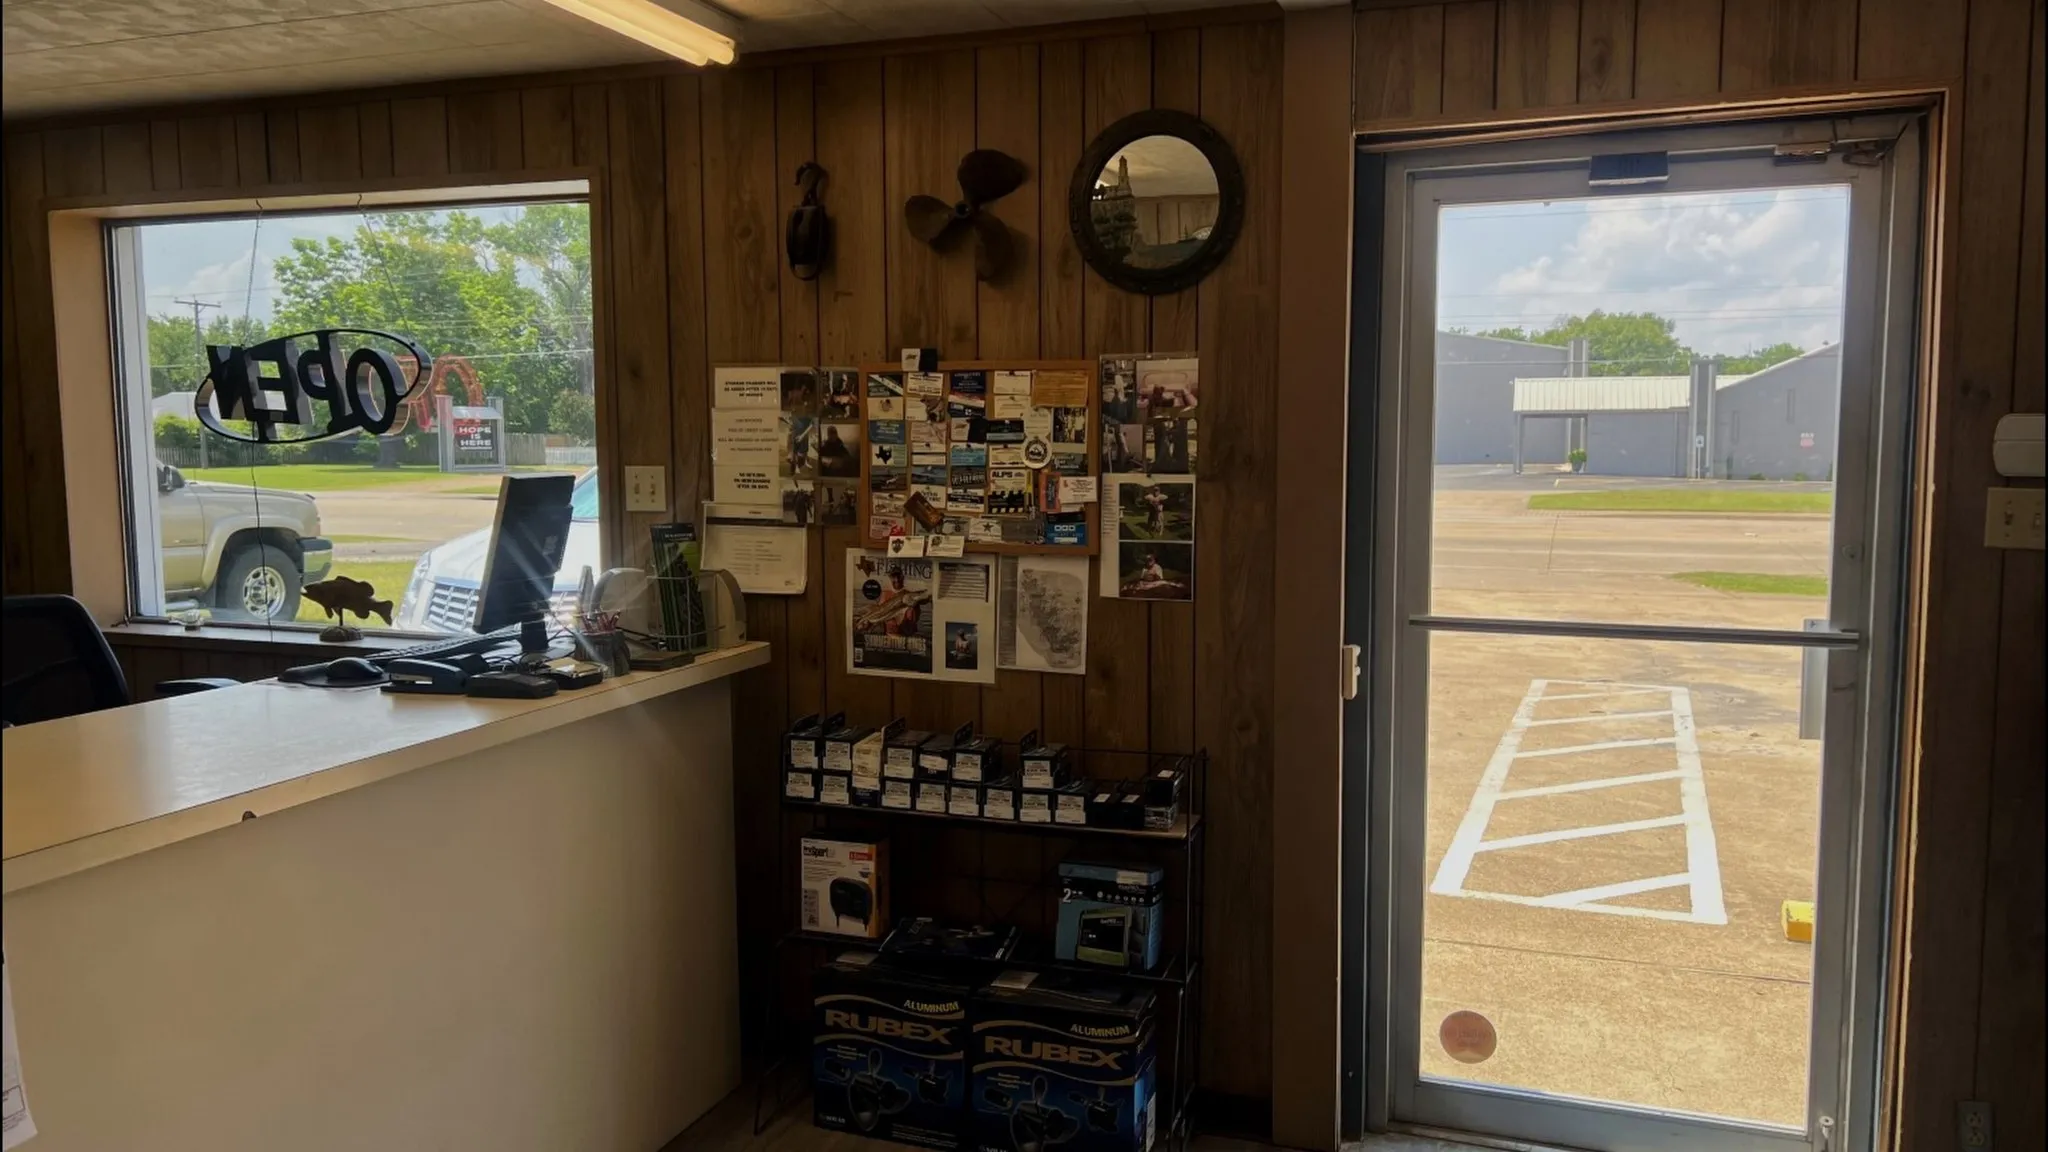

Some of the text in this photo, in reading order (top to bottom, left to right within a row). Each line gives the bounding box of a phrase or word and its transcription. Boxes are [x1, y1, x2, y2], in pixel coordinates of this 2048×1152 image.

[991, 470, 1013, 478] ALPS
[1062, 887, 1072, 903] 2
[903, 998, 960, 1013] ALUMINUM
[824, 1008, 953, 1045] RUBEX
[1069, 1023, 1130, 1037] ALUMINUM
[984, 1034, 1122, 1070] RUBEX
